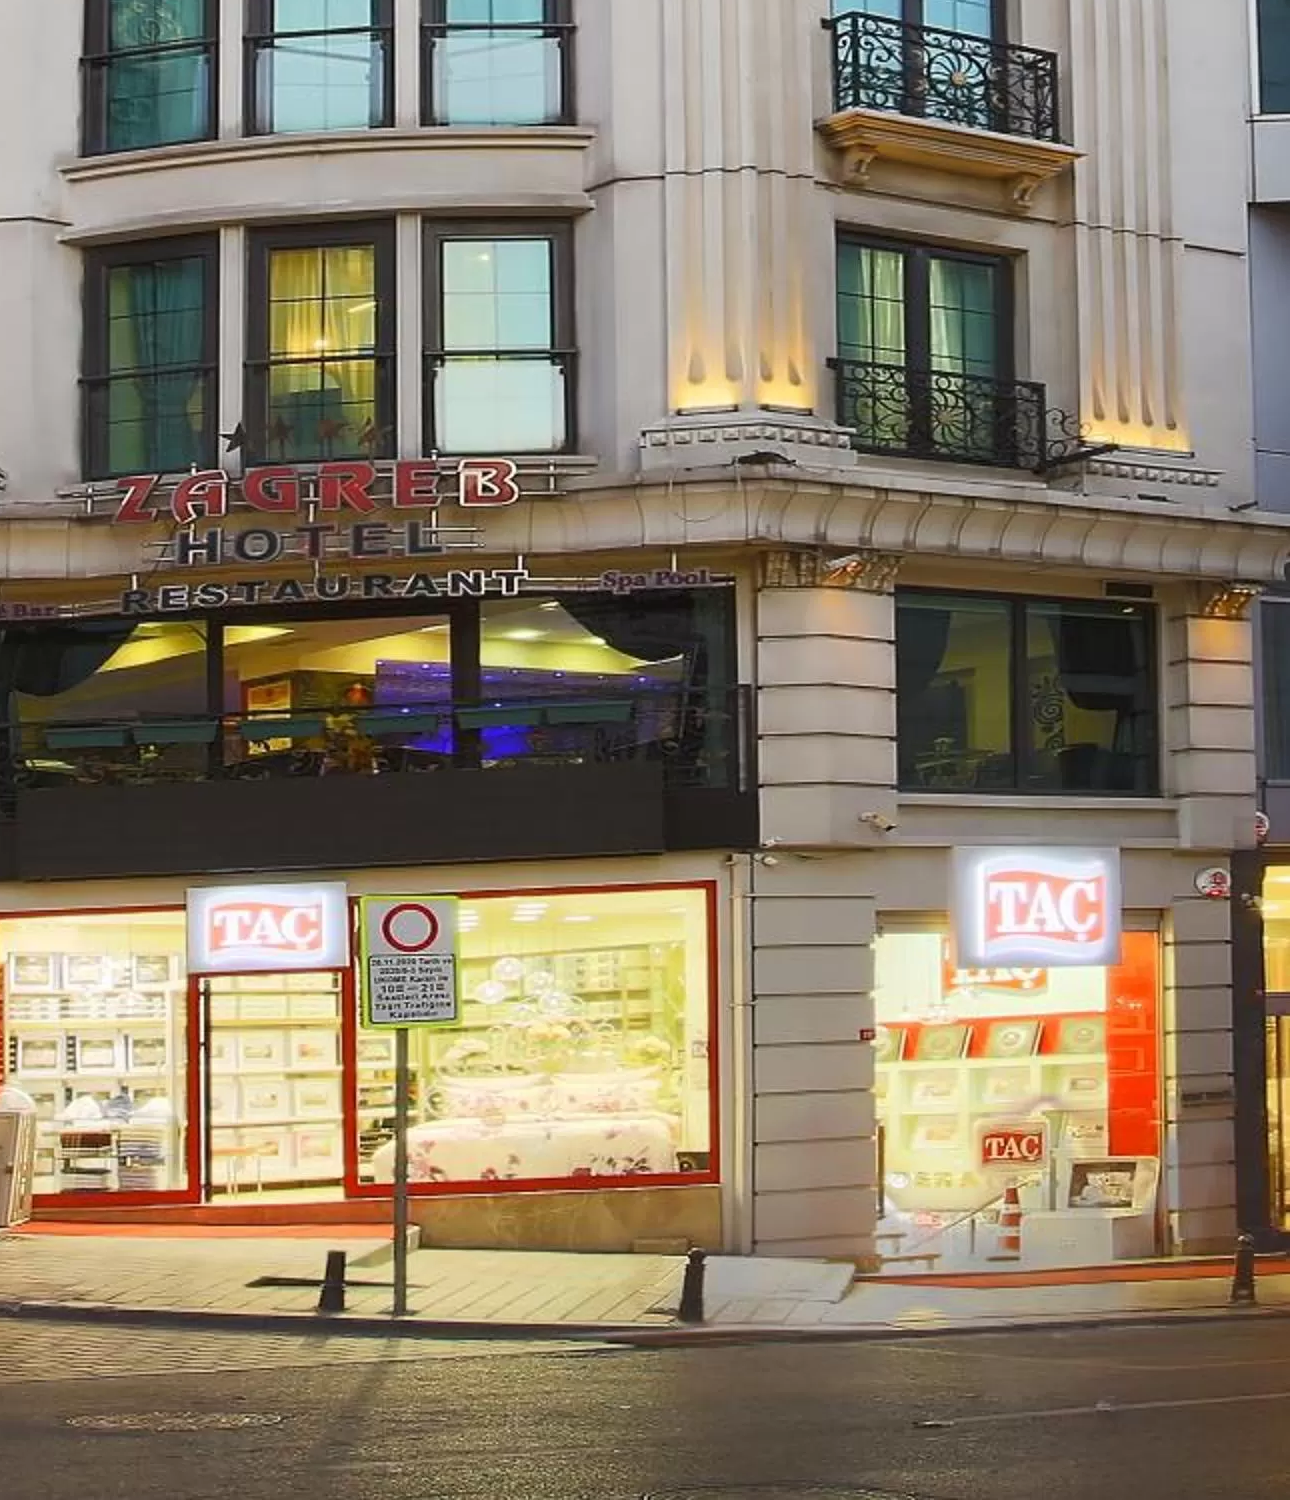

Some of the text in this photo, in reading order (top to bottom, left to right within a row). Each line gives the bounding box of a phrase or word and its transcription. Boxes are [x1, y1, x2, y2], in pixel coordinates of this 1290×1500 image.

[115, 457, 519, 525] ZAGREB
[175, 520, 445, 567] HOTEL
[121, 570, 529, 617] RESTAURANT
[602, 567, 710, 594] Spa Pool
[13, 602, 55, 618] Bar
[213, 907, 320, 951] TAÇ
[988, 880, 1100, 943] TAÇ
[985, 1135, 1041, 1161] TAÇ
